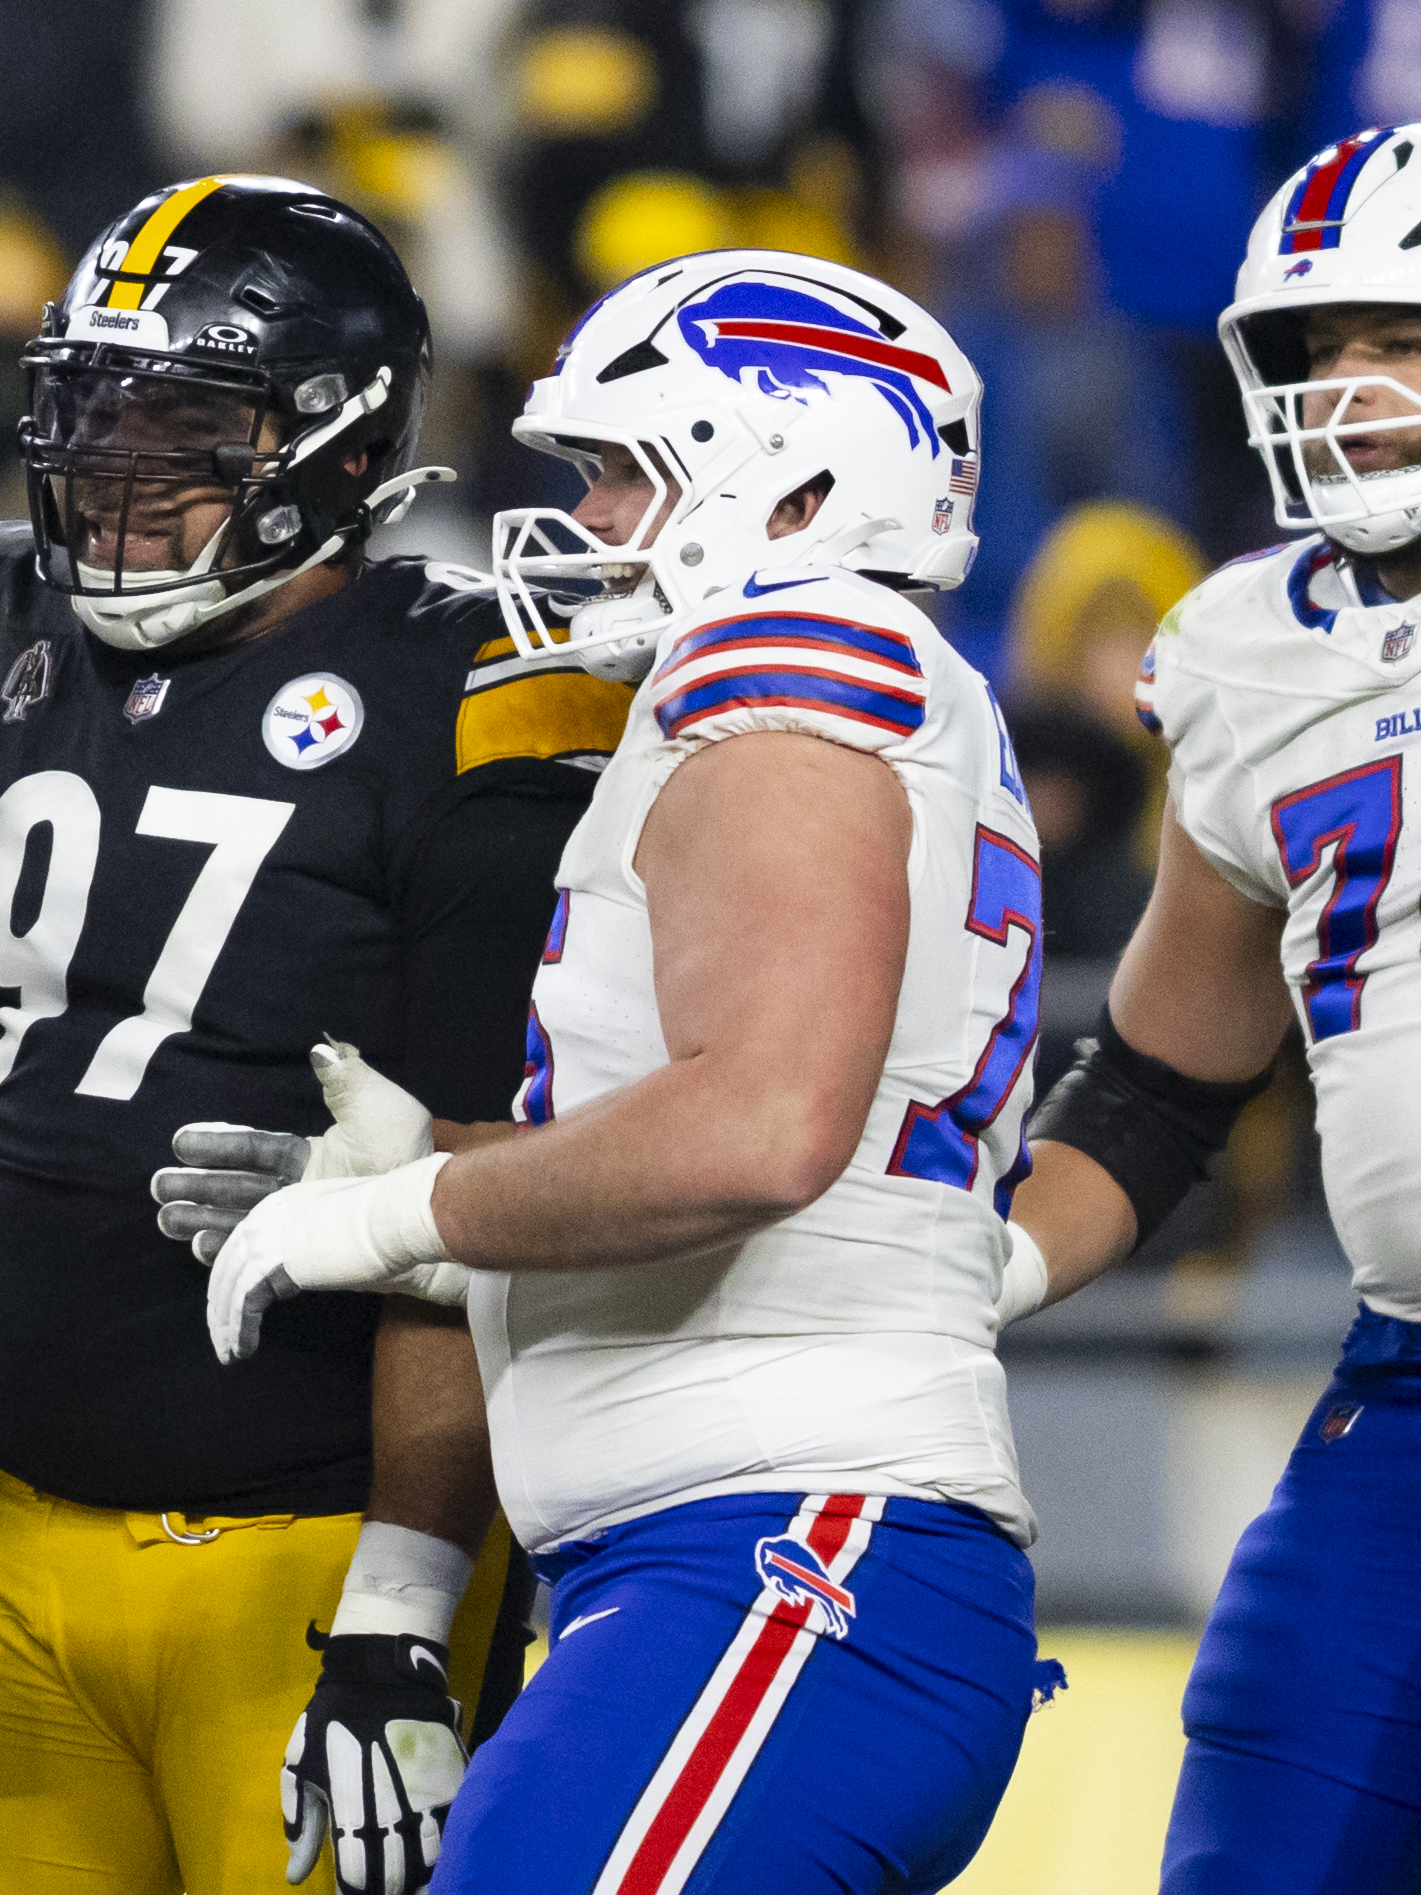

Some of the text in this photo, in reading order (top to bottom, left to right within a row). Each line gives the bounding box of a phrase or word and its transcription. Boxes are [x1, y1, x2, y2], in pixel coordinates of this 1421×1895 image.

[89, 311, 141, 331] Steelers
[196, 337, 257, 355] OAKLEY
[273, 705, 310, 723] Steelers
[1271, 753, 1421, 1045] 7
[885, 821, 1043, 1223] 7
